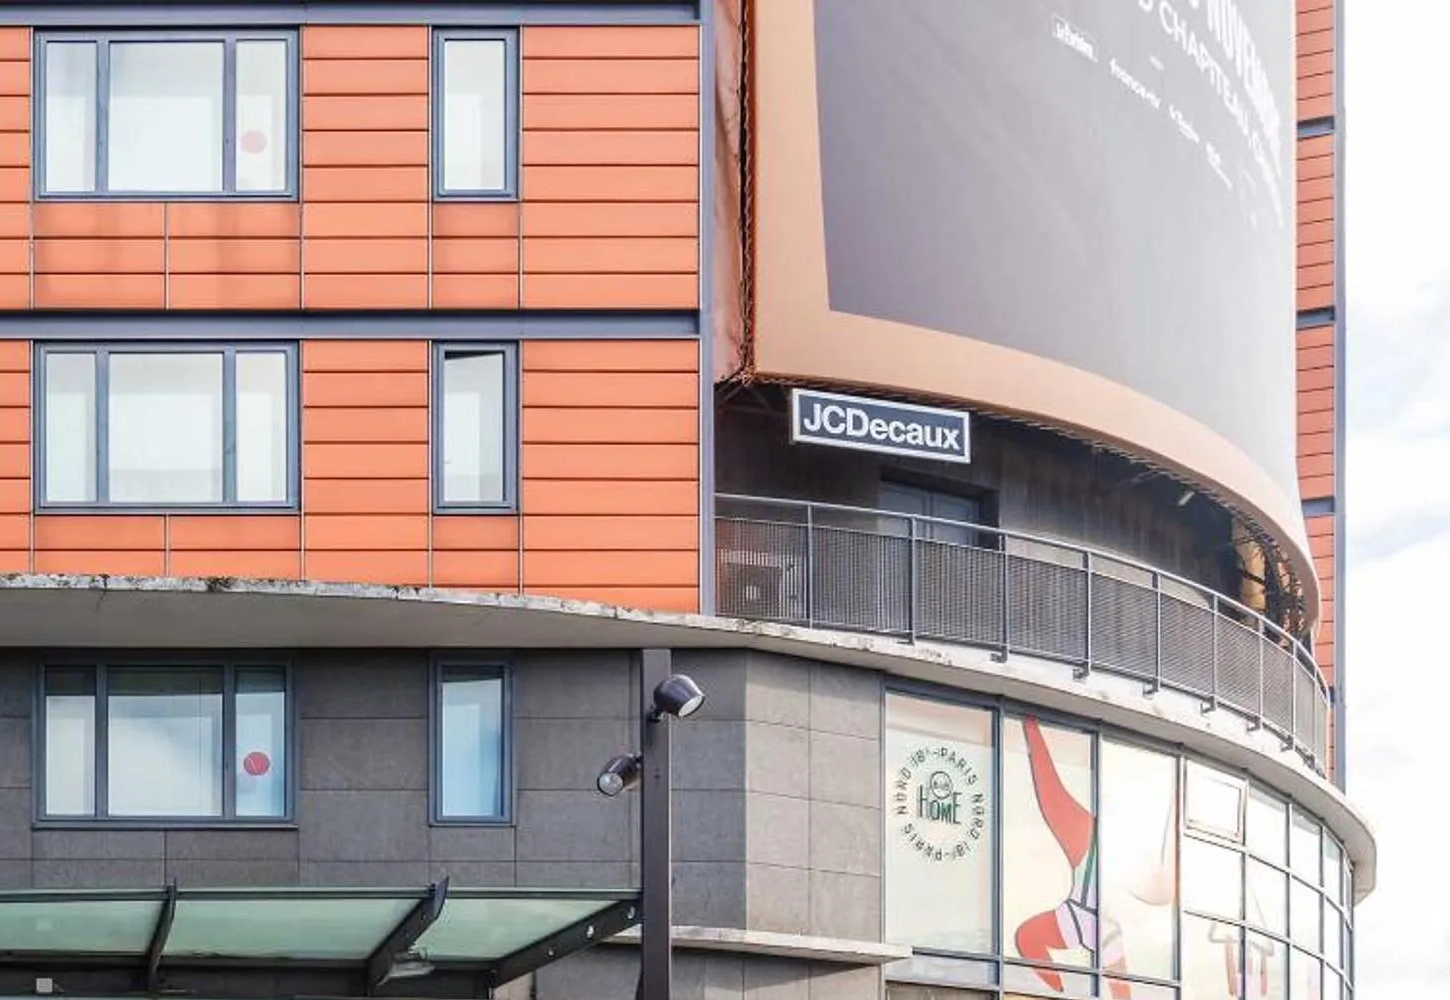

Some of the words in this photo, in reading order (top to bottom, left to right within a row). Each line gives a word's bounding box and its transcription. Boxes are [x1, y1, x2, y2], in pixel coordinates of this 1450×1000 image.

[803, 403, 961, 450] JCDecaux
[940, 746, 979, 786] PARIS
[916, 783, 963, 825] HOME
